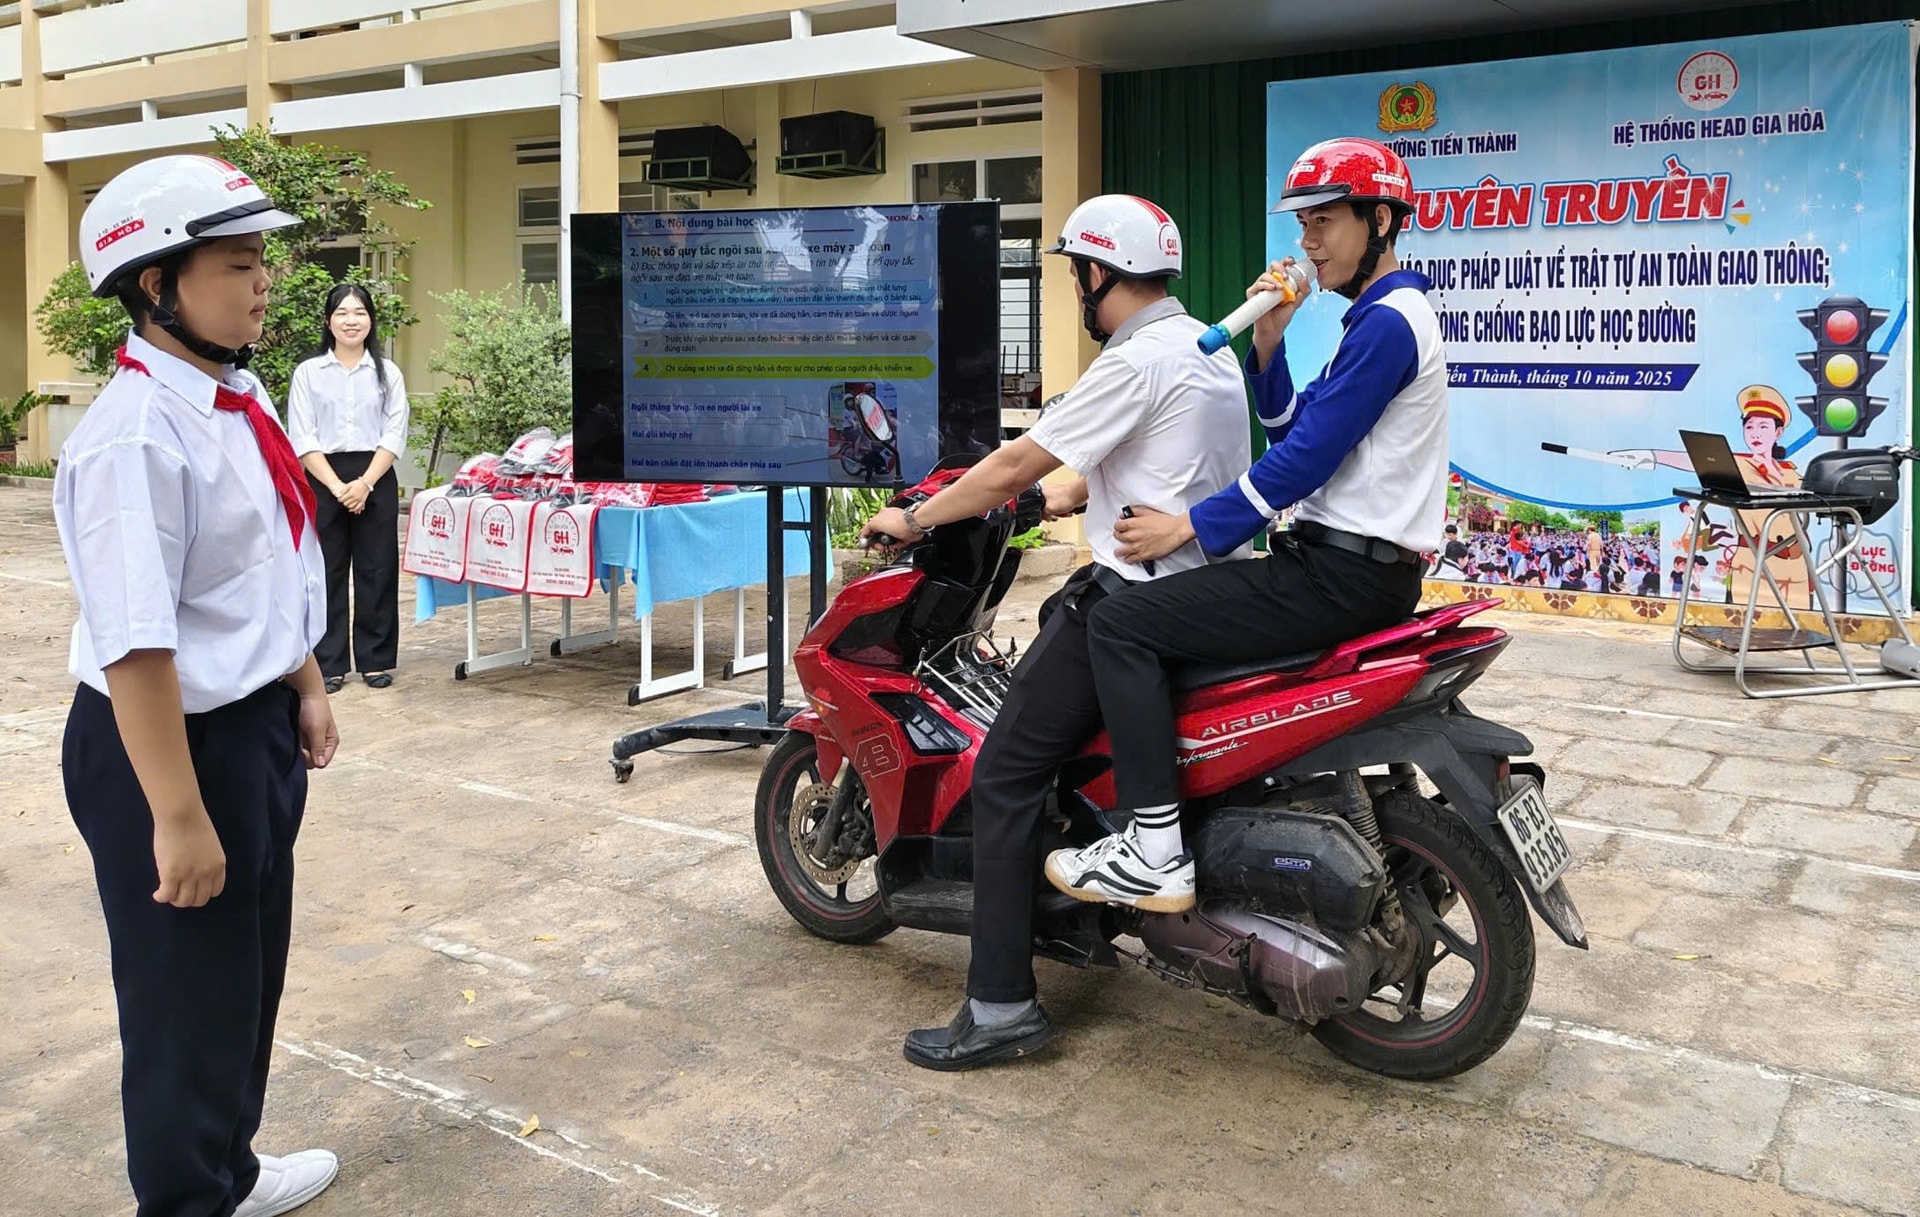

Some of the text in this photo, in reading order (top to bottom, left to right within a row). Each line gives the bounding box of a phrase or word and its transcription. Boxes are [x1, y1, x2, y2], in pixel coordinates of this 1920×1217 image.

[1695, 74, 1721, 90] GH
[1614, 108, 1825, 147] HỆ THỐNG HEAD GIA HÒA
[1431, 133, 1463, 156] TIẾN
[1467, 132, 1517, 154] THÀNH
[1541, 157, 1730, 227] TRUYỀN
[655, 216, 754, 230] B. Nội dung bài học
[630, 248, 639, 257] 2.
[641, 246, 662, 258] Một
[663, 244, 676, 257] số
[678, 247, 697, 259] quy
[700, 243, 716, 255] tắc
[718, 243, 742, 258] ngồi
[744, 248, 762, 256] sau
[808, 245, 821, 254] xe
[823, 242, 847, 255] máy
[884, 258, 900, 268] quy
[1428, 258, 1457, 297] DỤC
[1461, 251, 1500, 290] PHÁP
[1505, 249, 1542, 297] LUẬT
[1547, 244, 1565, 288] VỀ
[1570, 247, 1609, 296] TRẬT
[1614, 250, 1636, 295] TỰ
[1638, 252, 1662, 287] AN
[1667, 244, 1712, 286] TOÀN
[1717, 250, 1758, 286] GIAO
[1764, 241, 1830, 289] THÔNG;
[1435, 299, 1696, 350] ÒNG CHỐNG BẠO LỰC HỌC ĐƯỜNG
[1472, 368, 1522, 386] Thành,
[1526, 369, 1569, 388] tháng
[1574, 369, 1592, 385] 10
[1595, 370, 1630, 385] năm
[1634, 370, 1673, 386] 2025
[431, 515, 446, 529] GH
[489, 522, 504, 538] GH
[553, 530, 569, 544] GH
[1861, 546, 1886, 560] LỰC
[1202, 690, 1352, 738] AIRBLADE
